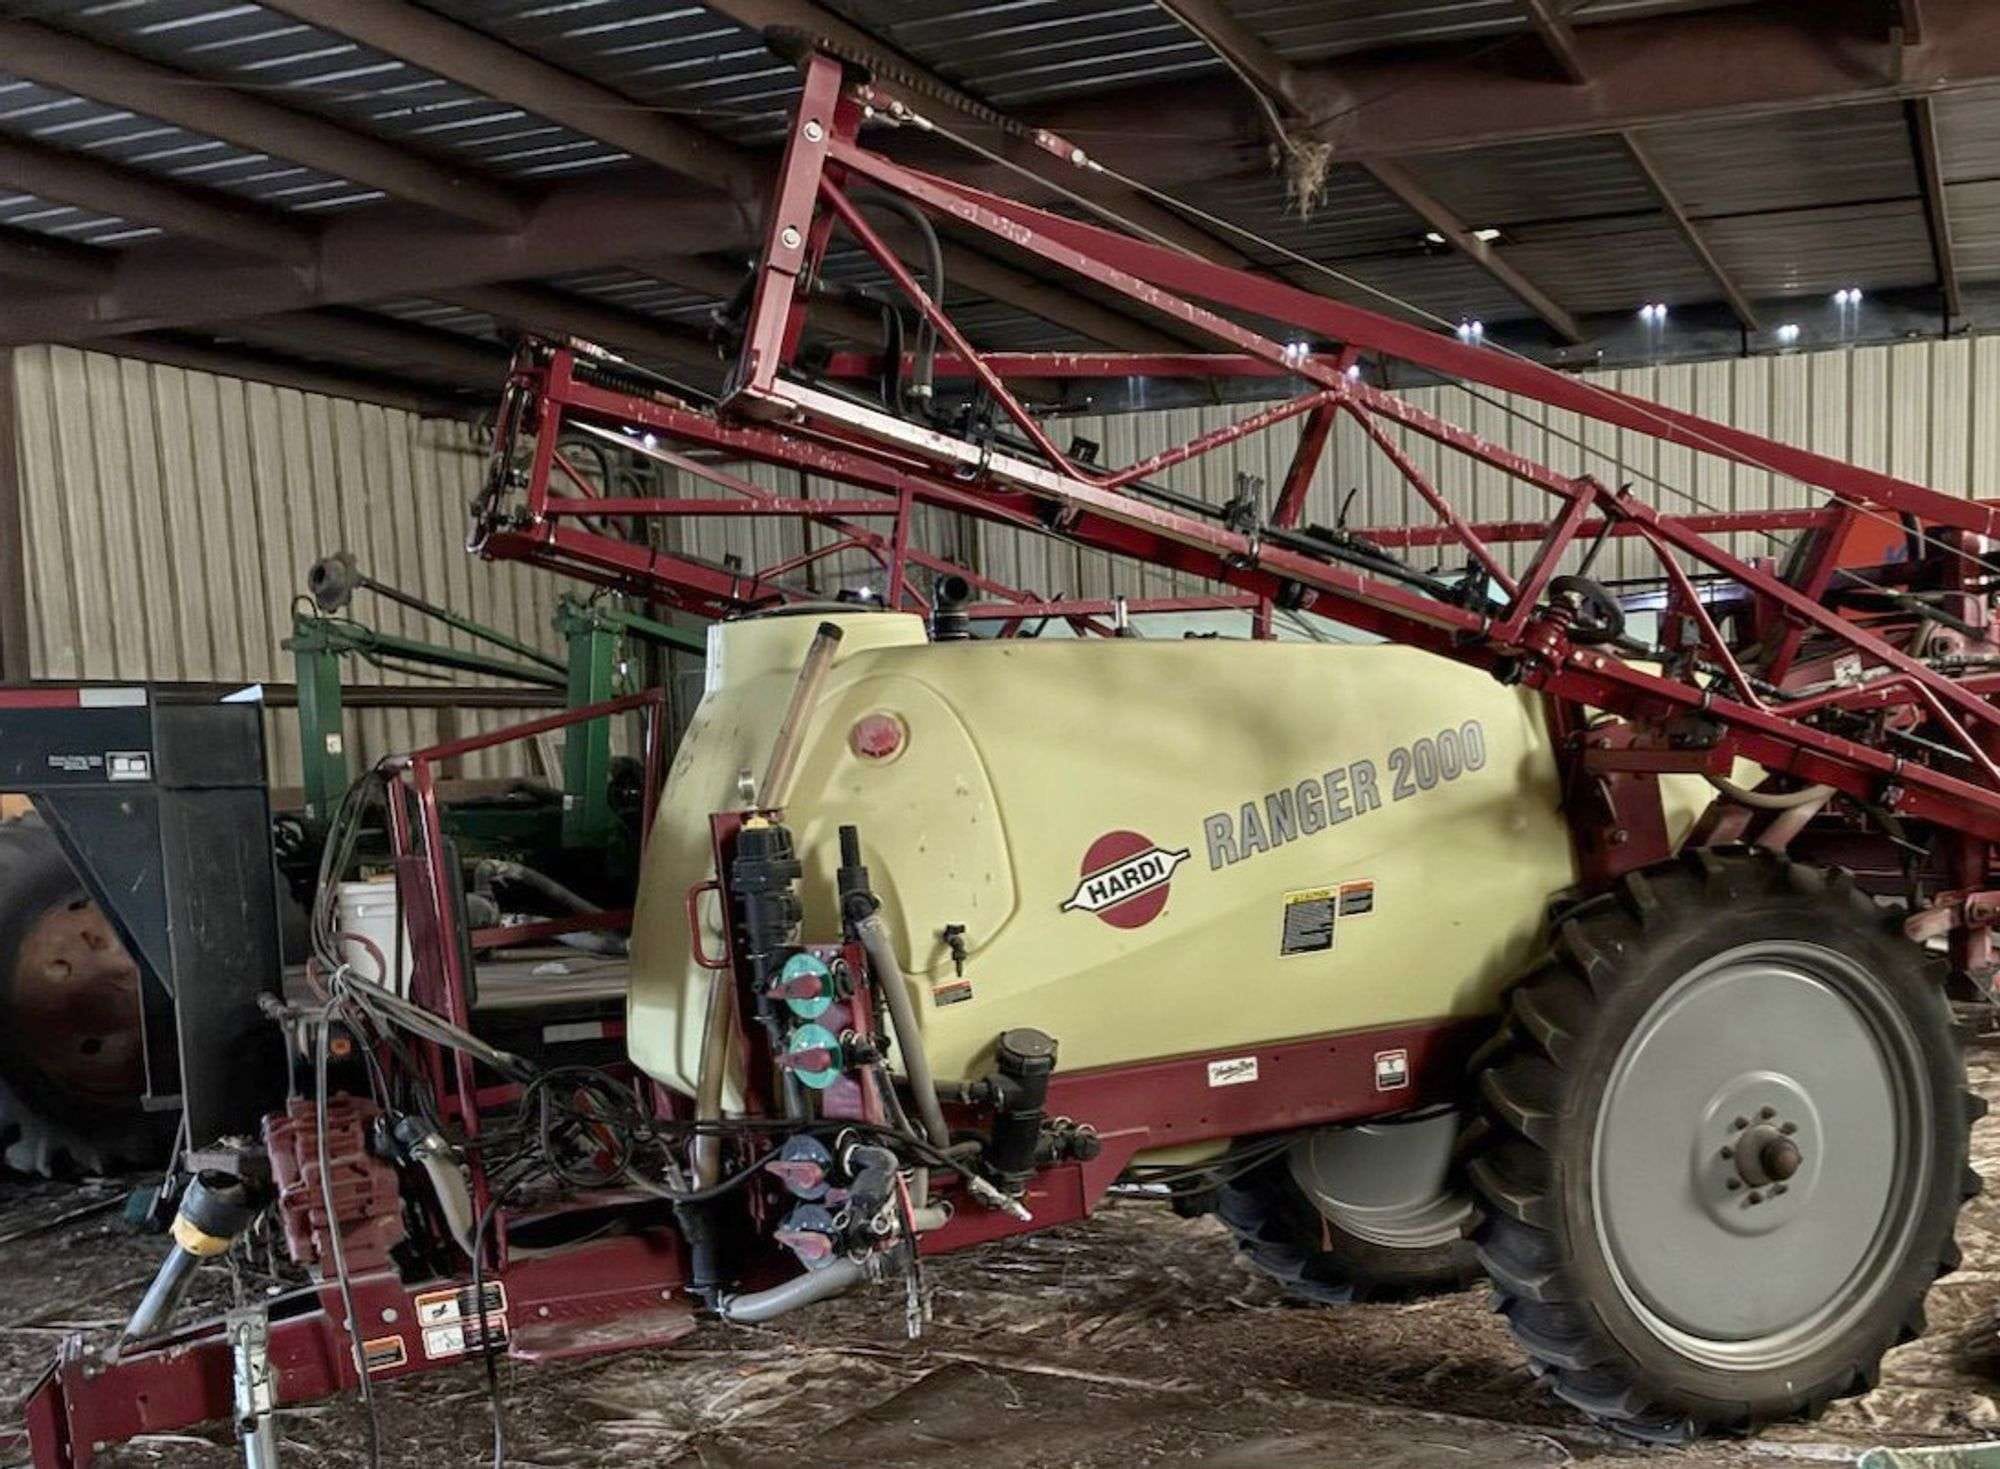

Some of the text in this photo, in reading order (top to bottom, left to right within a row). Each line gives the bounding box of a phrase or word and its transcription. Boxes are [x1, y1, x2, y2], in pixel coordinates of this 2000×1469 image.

[1203, 719, 1486, 871] RANGER 2000
[1087, 855, 1164, 904] HARDI
